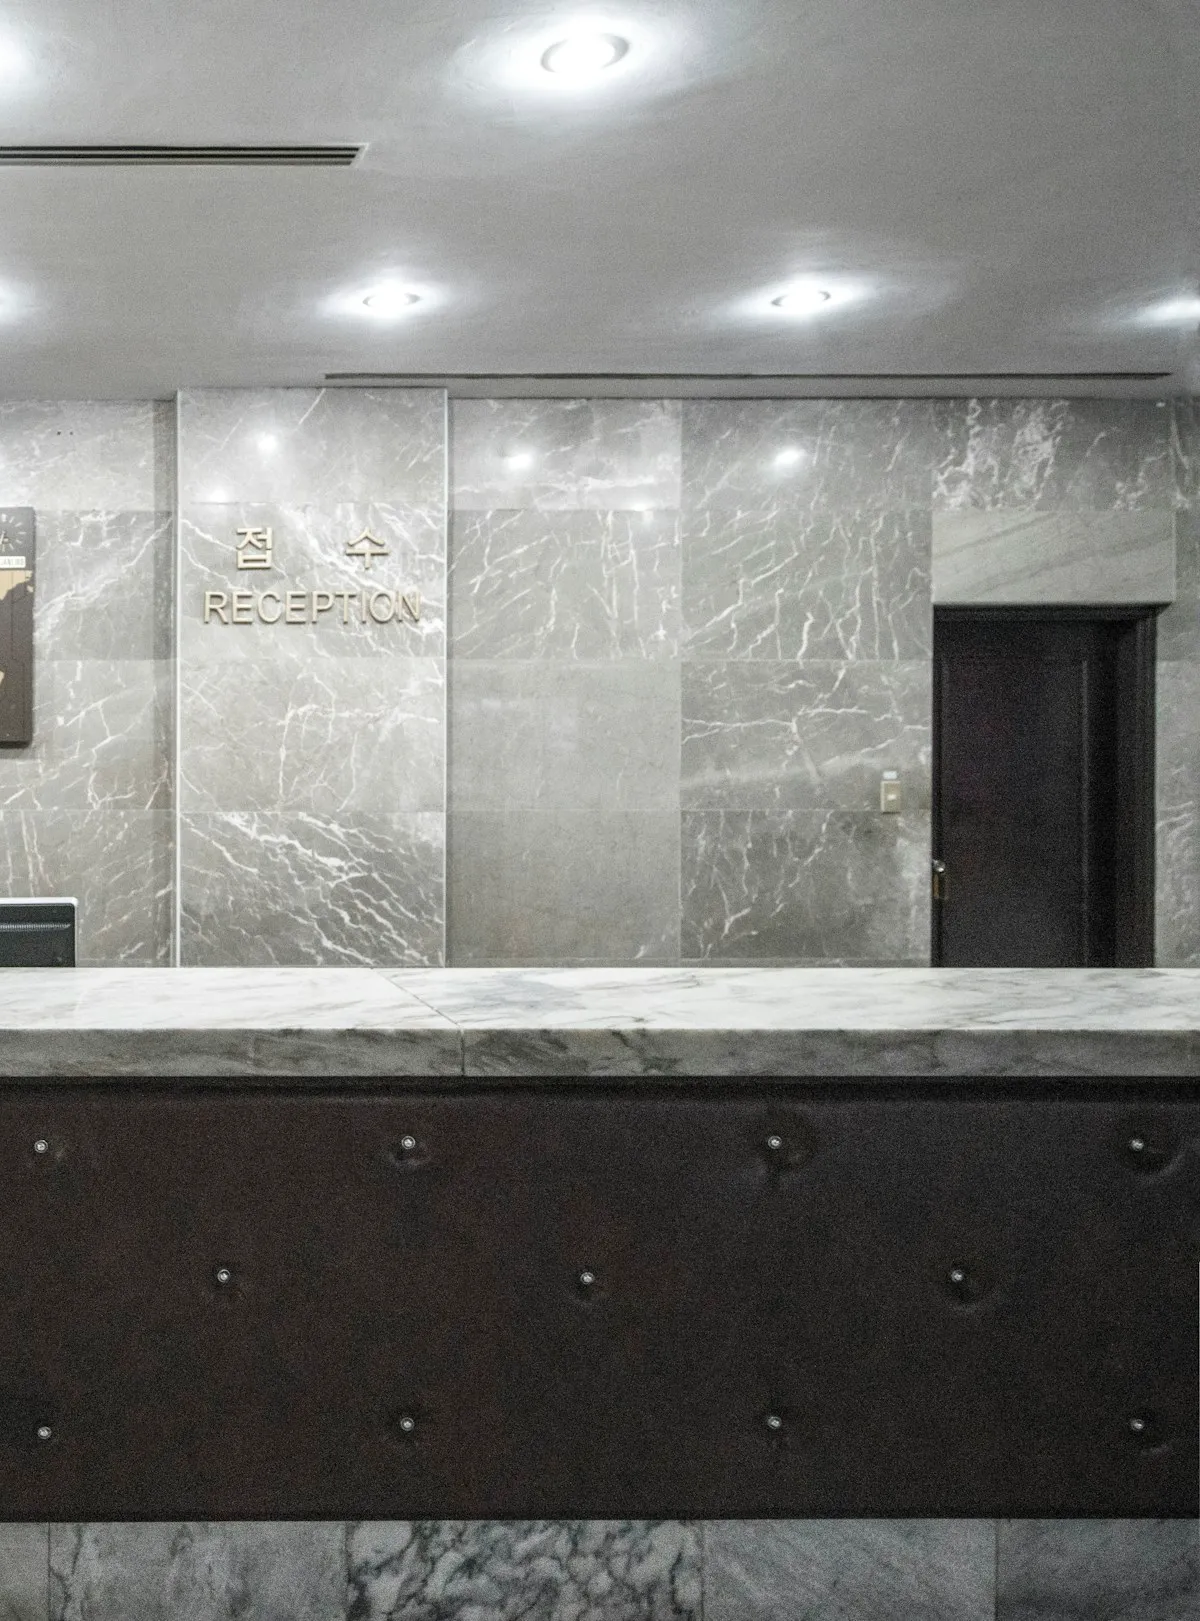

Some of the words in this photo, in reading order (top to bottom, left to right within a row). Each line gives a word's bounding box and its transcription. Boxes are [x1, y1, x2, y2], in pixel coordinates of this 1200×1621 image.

[235, 527, 273, 570] 접
[344, 526, 389, 571] 수
[203, 590, 422, 625] RECEPTION
